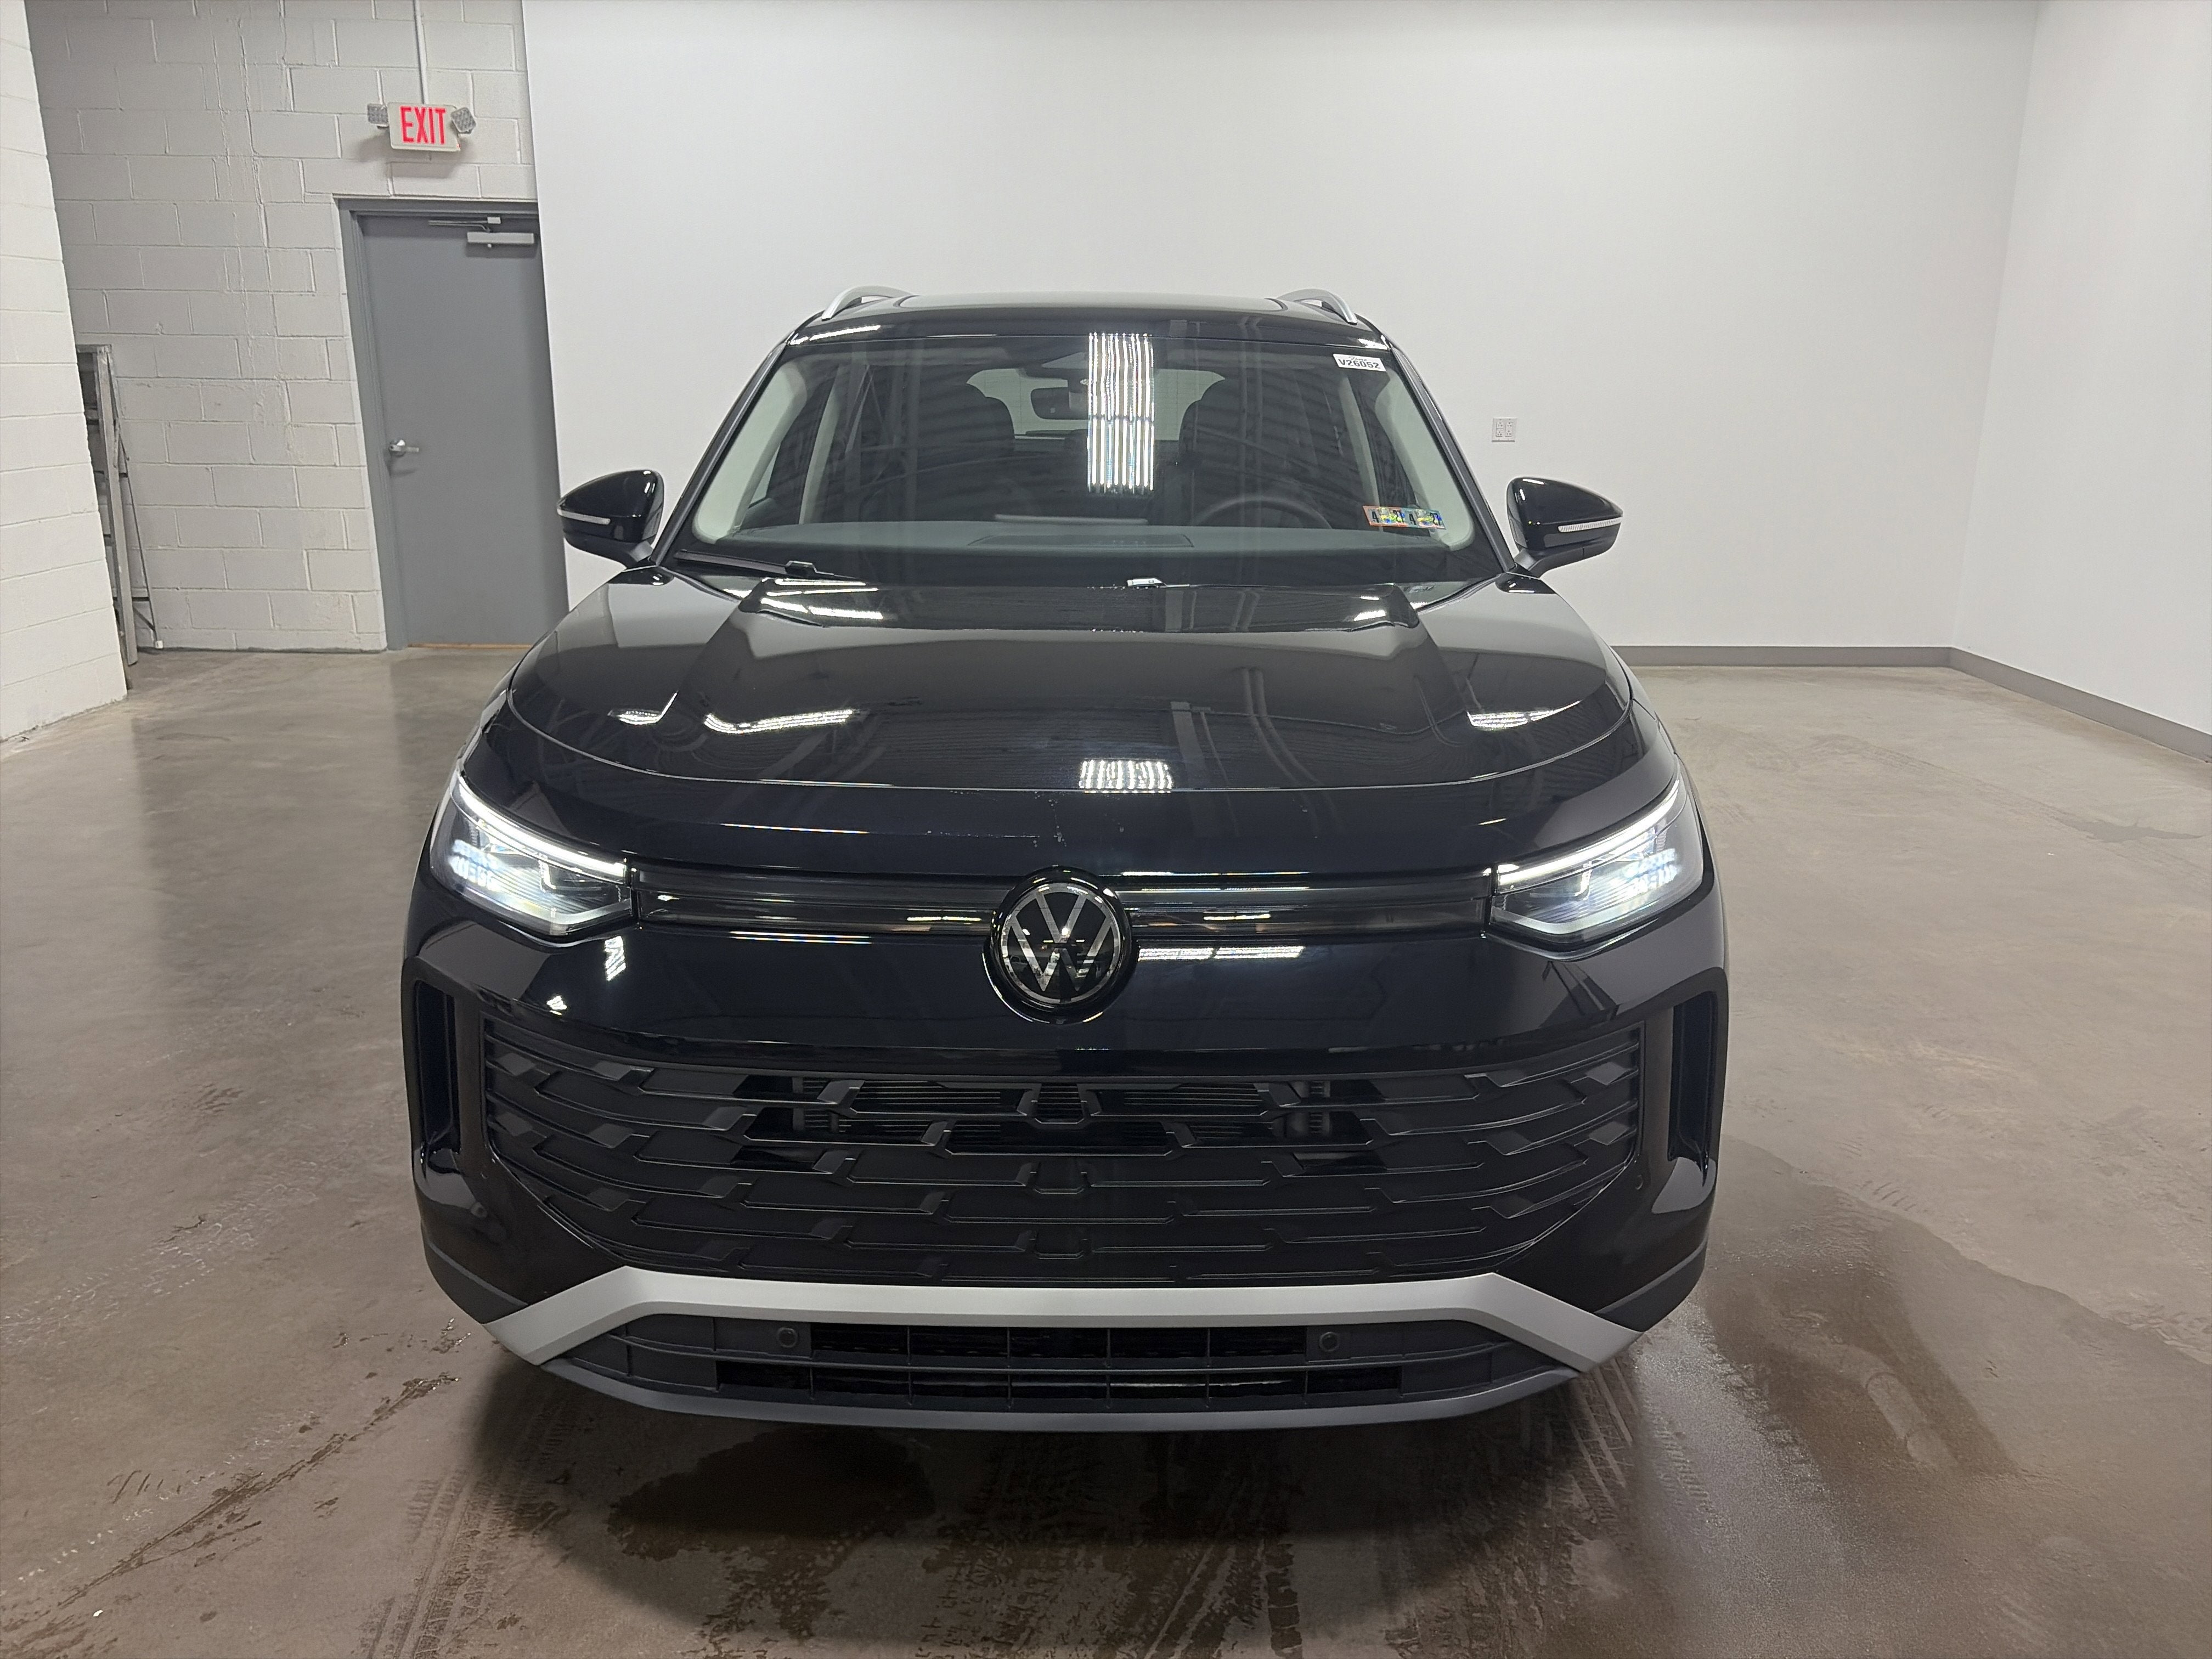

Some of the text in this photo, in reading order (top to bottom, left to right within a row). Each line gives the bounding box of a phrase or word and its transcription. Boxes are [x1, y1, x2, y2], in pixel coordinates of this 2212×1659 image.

[399, 105, 446, 144] EXIT
[1338, 359, 1381, 369] V26052
[1372, 511, 1379, 523] 4
[1409, 513, 1417, 526] 4
[1007, 884, 1115, 994] VW
